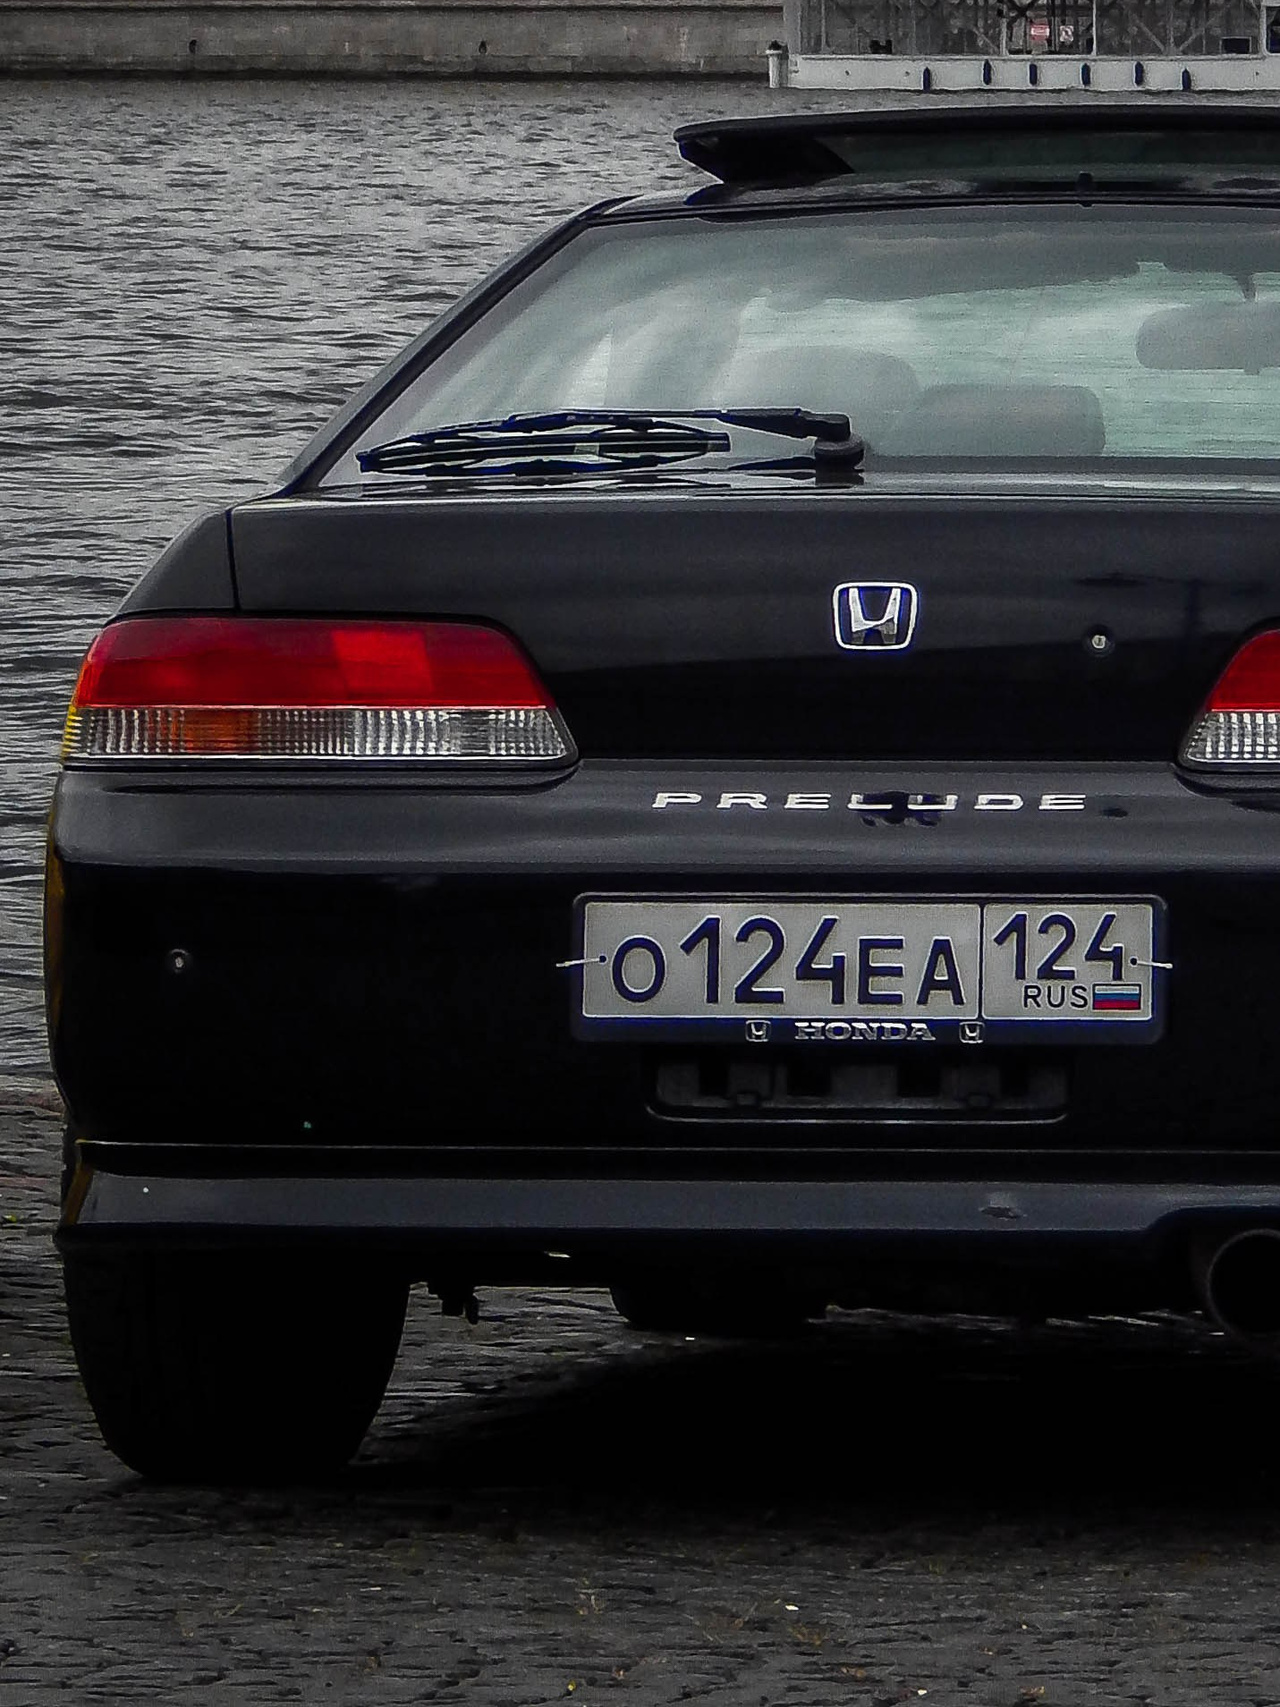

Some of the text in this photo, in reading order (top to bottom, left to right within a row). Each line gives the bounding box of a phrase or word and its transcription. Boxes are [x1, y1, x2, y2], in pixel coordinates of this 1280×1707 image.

[652, 792, 1087, 810] PRELUDE
[611, 912, 1124, 1005] O124EA 124
[1023, 983, 1090, 1009] RUS
[794, 1021, 936, 1041] HONDA
